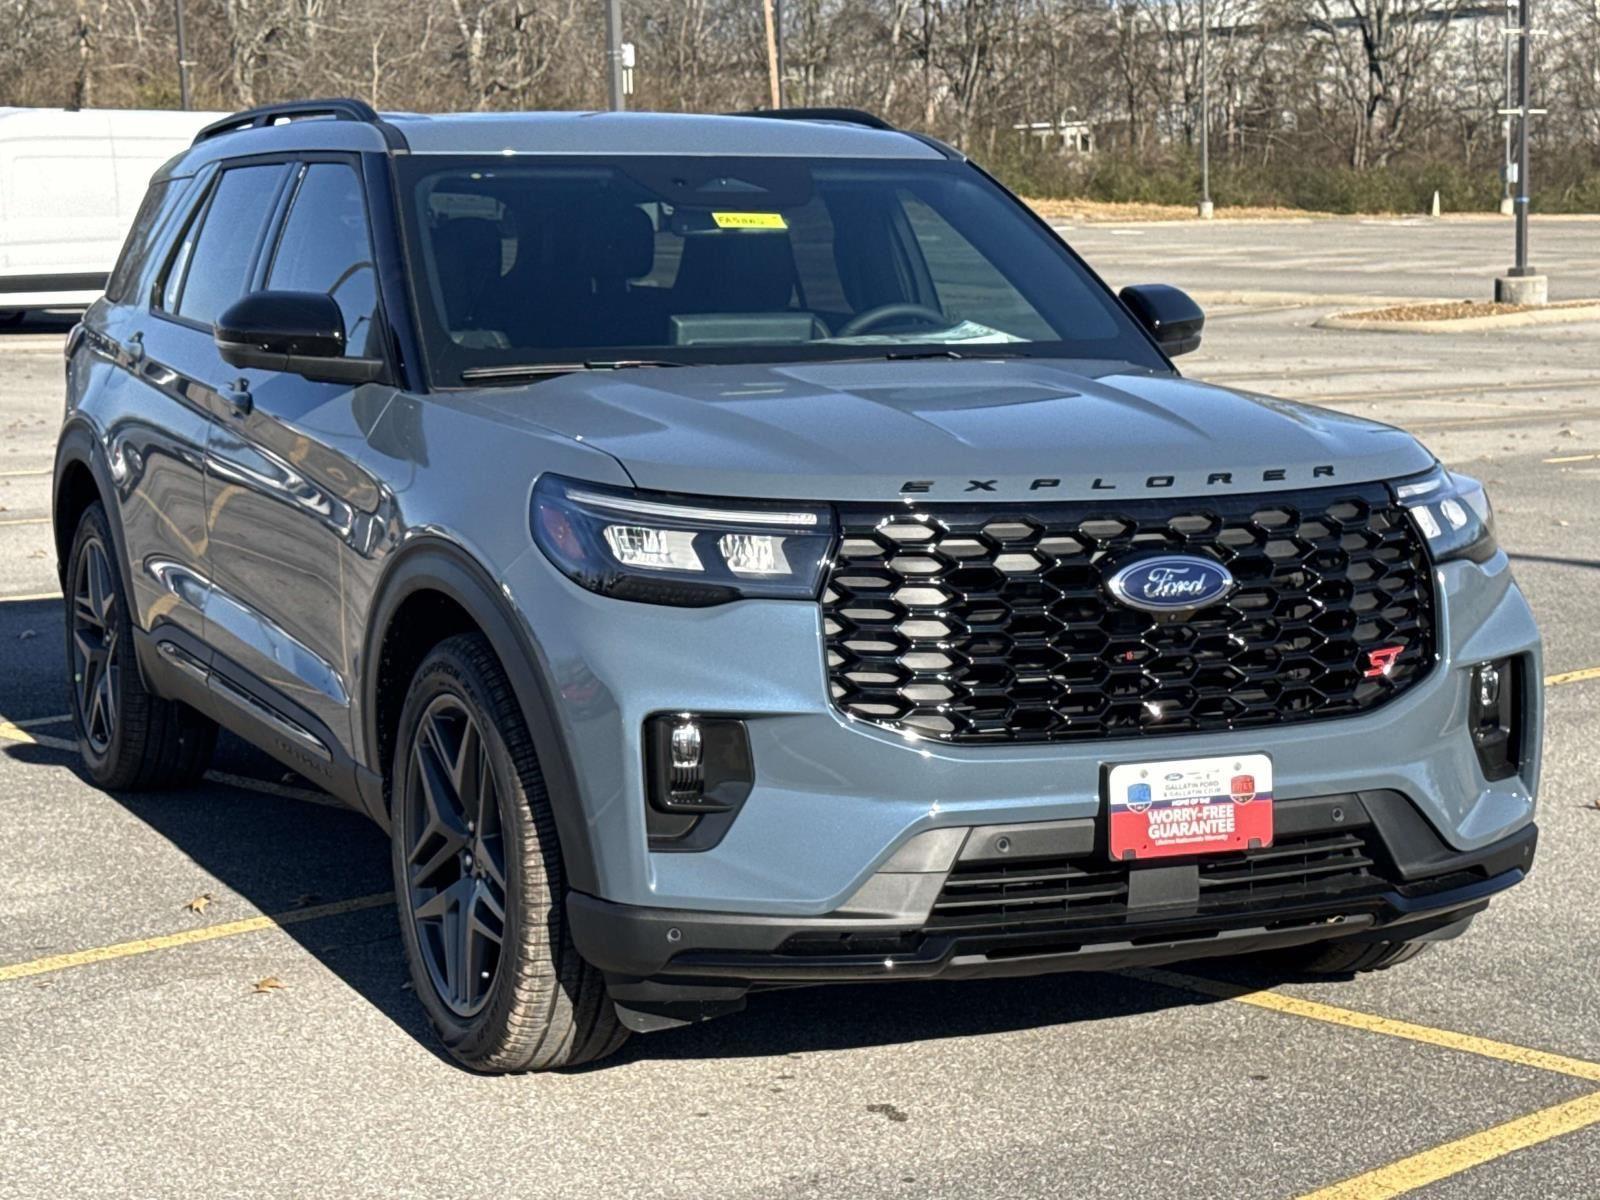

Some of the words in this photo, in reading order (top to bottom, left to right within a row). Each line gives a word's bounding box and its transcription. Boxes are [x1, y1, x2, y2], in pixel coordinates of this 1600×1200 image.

[901, 465, 1334, 493] EXPLORER
[1144, 567, 1207, 598] Ford
[1364, 646, 1405, 677] ST
[1165, 782, 1199, 791] GALLATIN
[1148, 804, 1235, 825] WORRY-FREE
[1147, 817, 1236, 840] GUARANTEE
